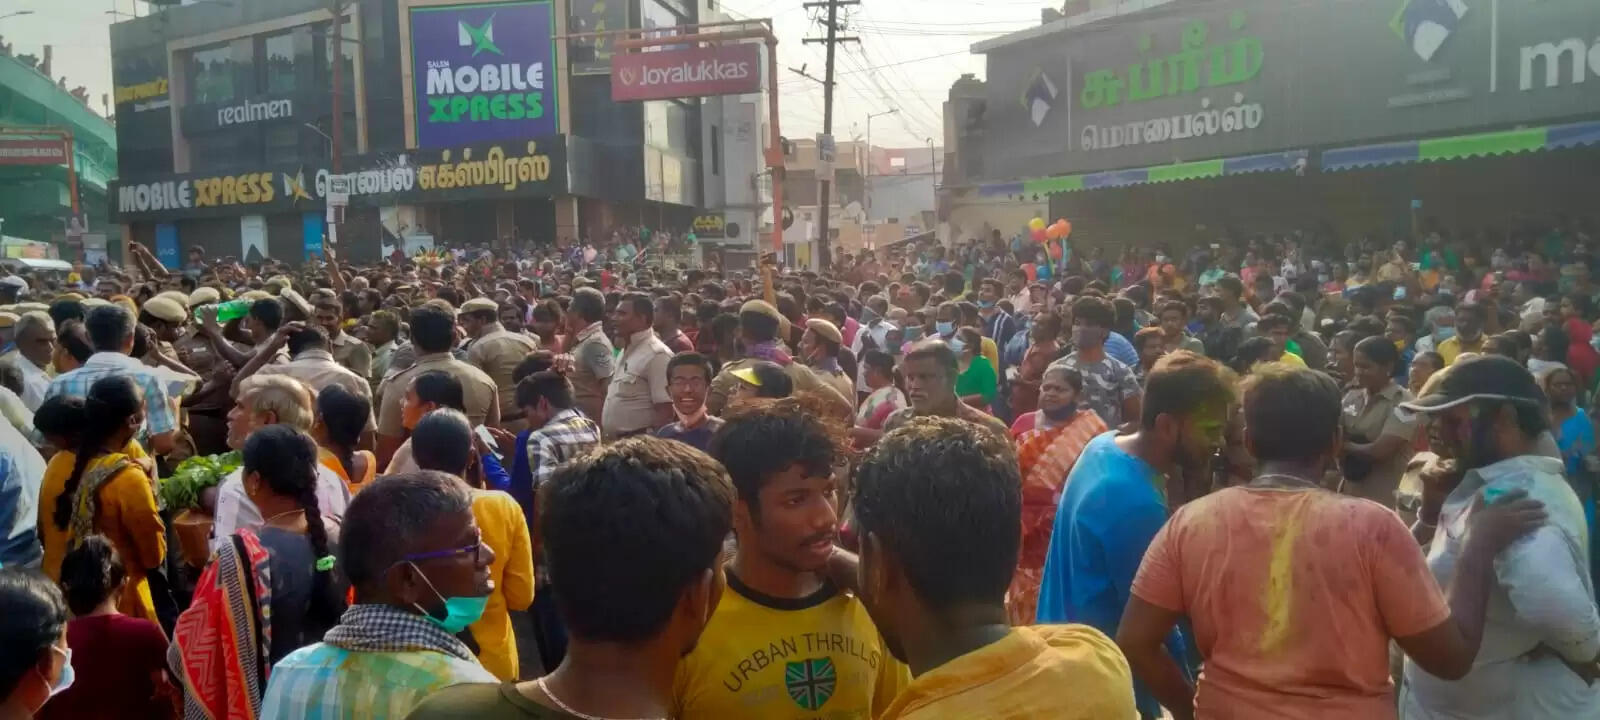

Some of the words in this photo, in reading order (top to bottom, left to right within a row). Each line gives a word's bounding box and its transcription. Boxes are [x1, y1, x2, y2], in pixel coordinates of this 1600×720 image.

[426, 62, 544, 95] MOBILE
[640, 60, 748, 86] Joyalukkas
[217, 98, 292, 126] realmen
[428, 92, 545, 123] XPRESS
[1080, 91, 1264, 151] மொபைல்ஸ்
[417, 141, 550, 191] எக்ஸ்பிரஸ்
[118, 180, 193, 213] MOBILE
[194, 172, 275, 207] XPRESS
[723, 636, 798, 693] URBAN
[802, 633, 880, 669] THRILLS
